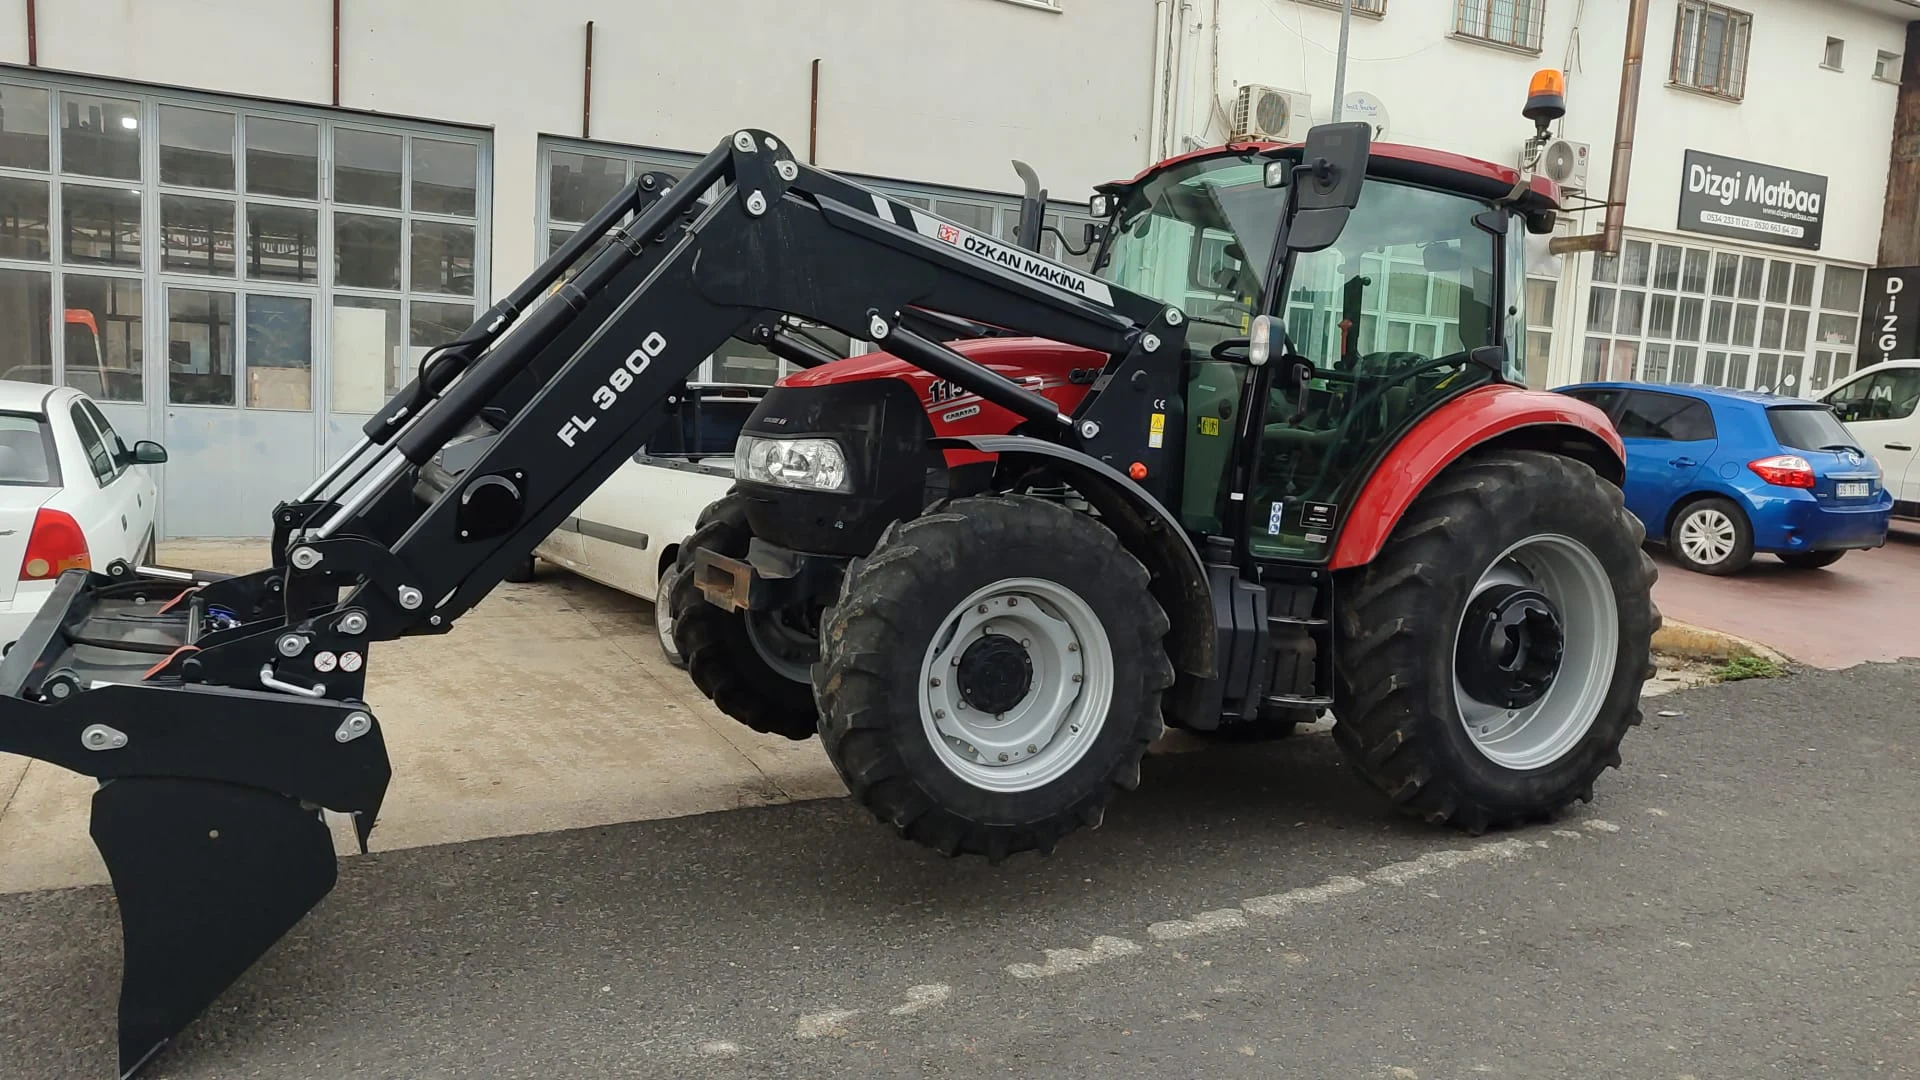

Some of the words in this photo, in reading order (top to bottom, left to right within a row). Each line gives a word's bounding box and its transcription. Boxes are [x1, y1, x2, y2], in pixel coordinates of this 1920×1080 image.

[1689, 164, 1741, 206] Dizgi
[1745, 174, 1821, 214] Matbaa
[963, 234, 1022, 269] ÖZKAN
[1024, 260, 1086, 294] MAKİNA
[557, 415, 597, 447] FL
[592, 331, 667, 410] 3800
[1154, 399, 1165, 410] CE
